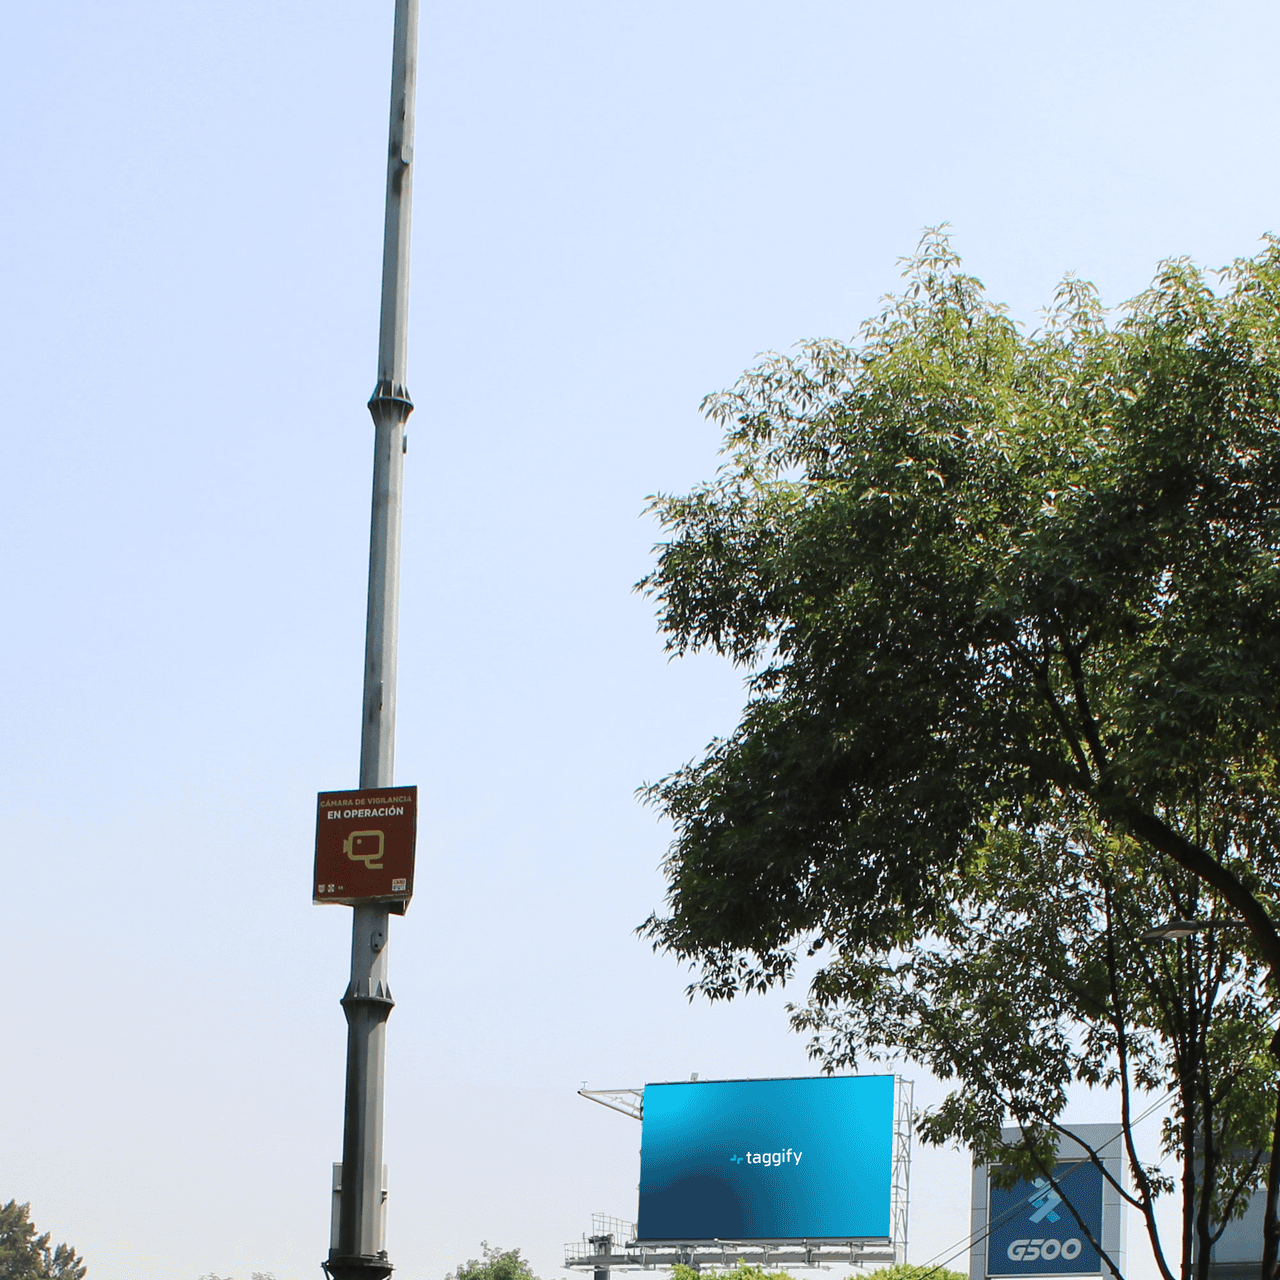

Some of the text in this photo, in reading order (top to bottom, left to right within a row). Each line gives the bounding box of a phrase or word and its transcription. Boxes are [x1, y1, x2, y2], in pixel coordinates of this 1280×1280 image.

[320, 795, 412, 808] CÁMARA DE VIGILANCIA
[327, 805, 404, 819] EN OPERACIÓN
[746, 1148, 803, 1167] taggify
[1007, 1238, 1082, 1261] G500
